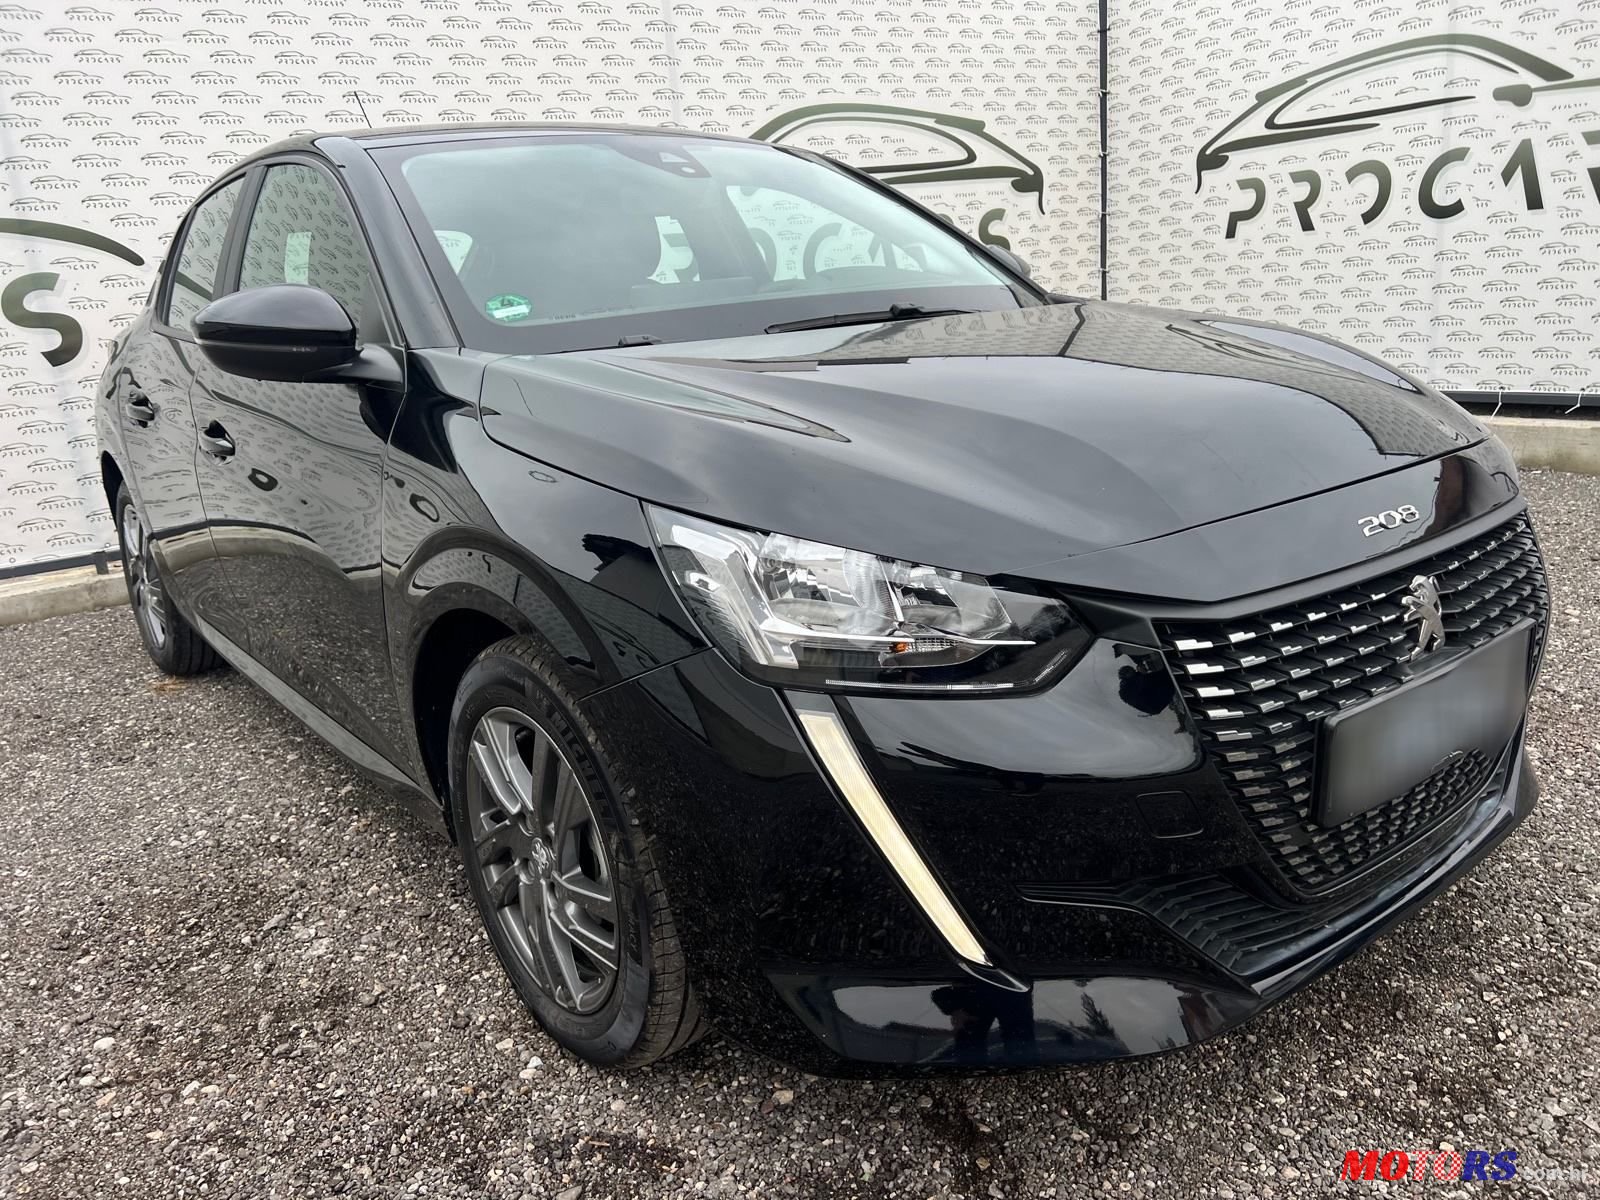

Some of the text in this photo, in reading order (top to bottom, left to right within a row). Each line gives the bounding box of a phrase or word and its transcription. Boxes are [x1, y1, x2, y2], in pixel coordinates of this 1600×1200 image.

[0, 12, 41, 20] ROCARS
[0, 120, 39, 128] ROCARS
[0, 410, 36, 419] ROCARS
[1358, 504, 1419, 537] 208
